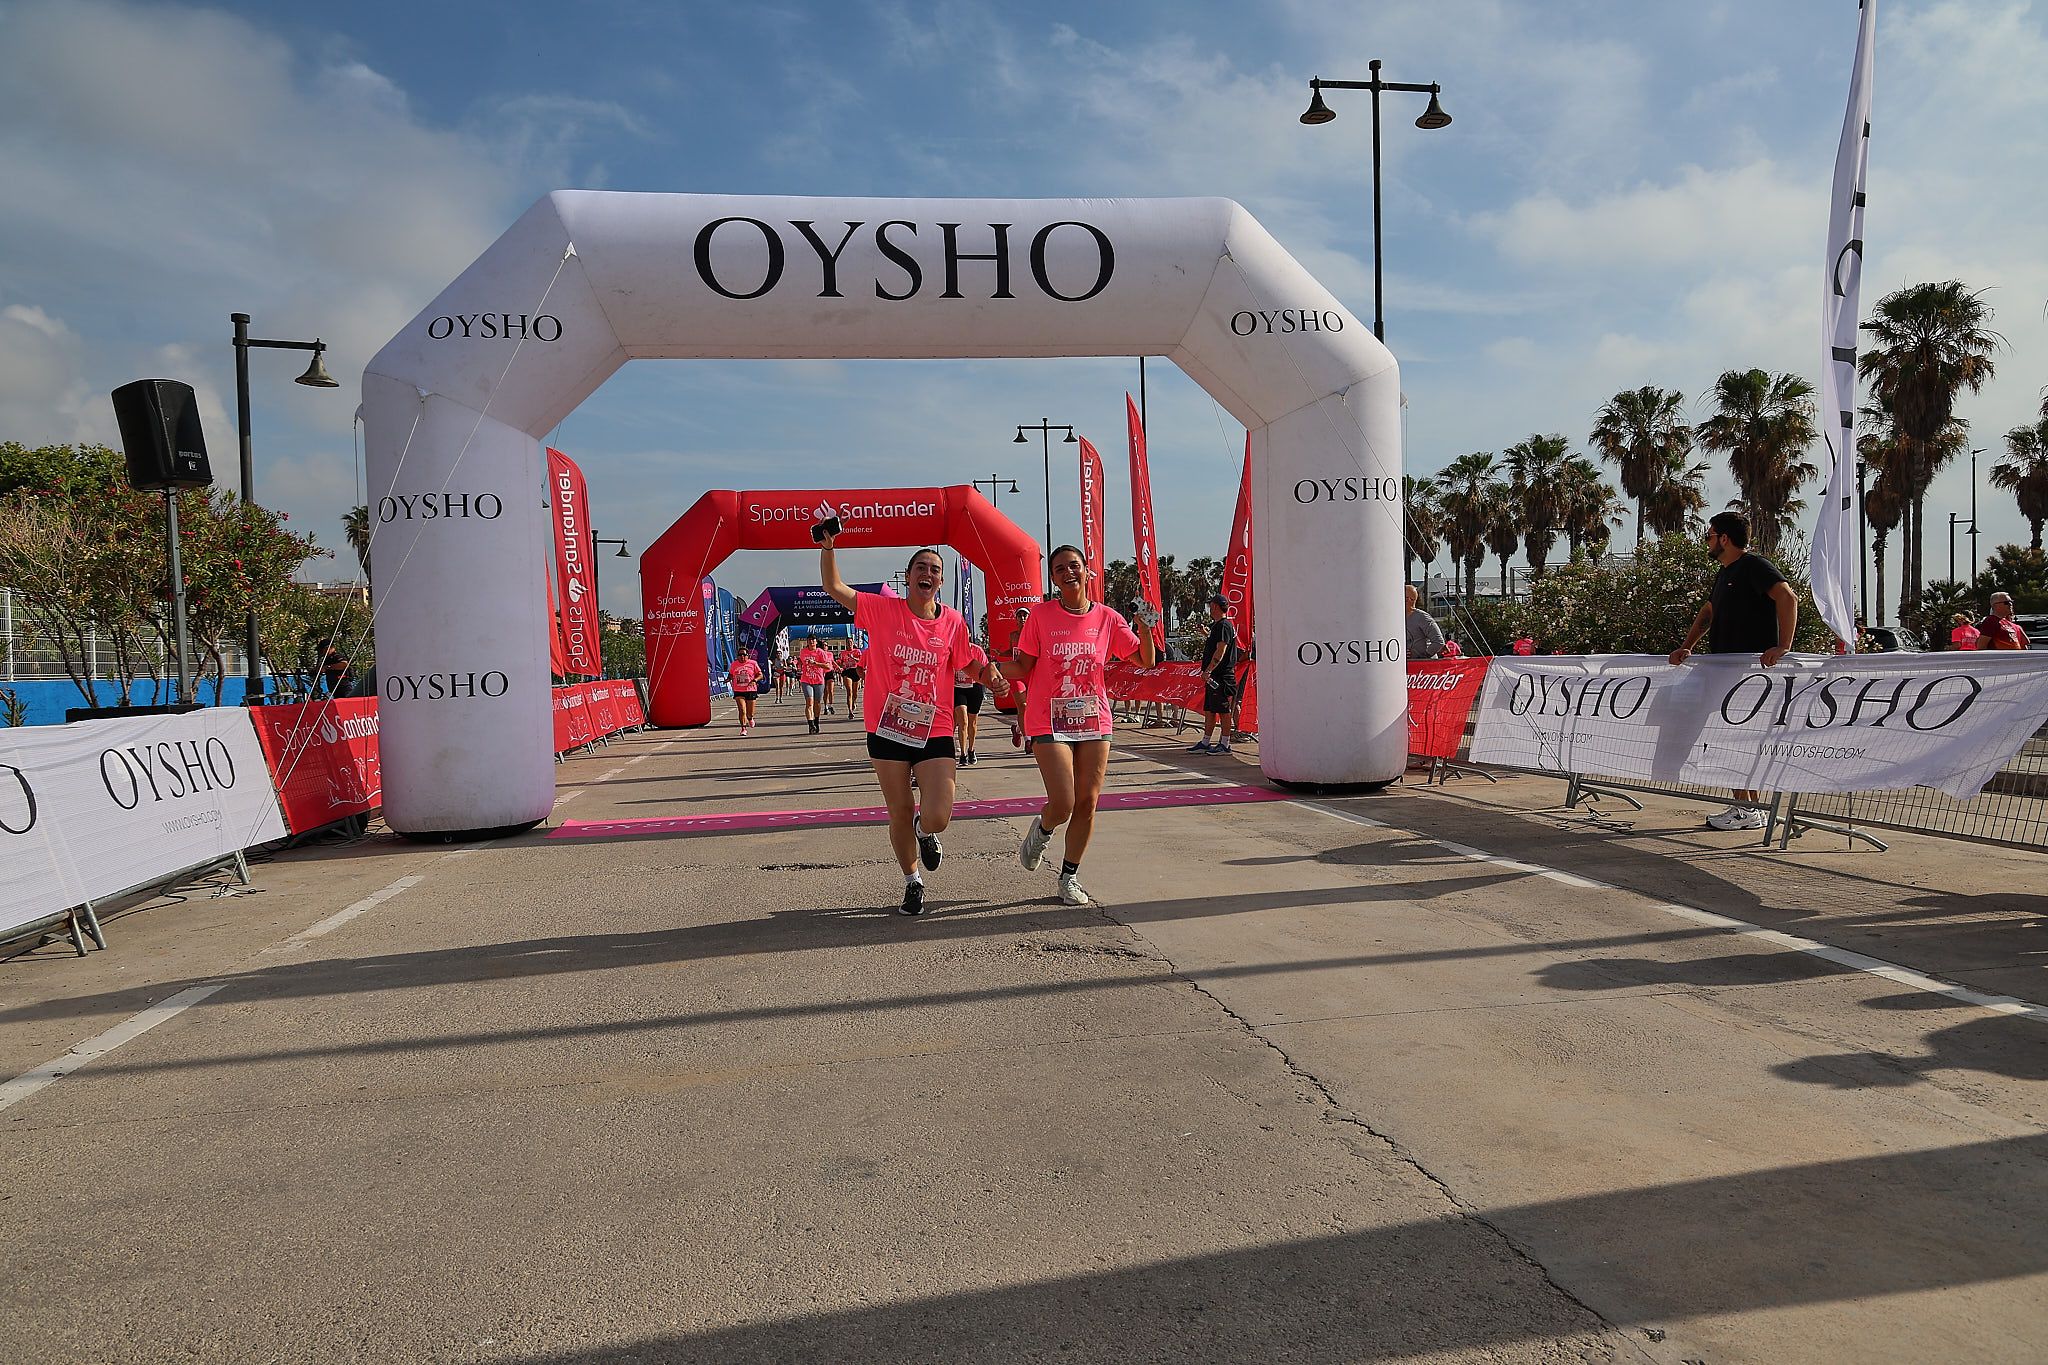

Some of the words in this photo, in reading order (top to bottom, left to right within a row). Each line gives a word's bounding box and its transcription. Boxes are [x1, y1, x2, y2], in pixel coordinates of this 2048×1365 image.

[693, 216, 1115, 301] OYSHO
[427, 313, 563, 342] OYSHO
[1230, 309, 1344, 336] OYSHO
[1293, 477, 1397, 503] OYSHO
[378, 493, 503, 523] OYSHO
[749, 503, 810, 526] Sports
[840, 501, 936, 519] Santander
[1005, 581, 1032, 592] Sports
[656, 595, 686, 606] Sports
[1004, 595, 1041, 604] Santander
[655, 609, 698, 619] Santander
[893, 643, 937, 667] CARRERA
[1052, 642, 1097, 656] CARRERA
[1297, 638, 1400, 666] OYSHO
[386, 670, 509, 702] OYSHO
[1407, 669, 1465, 690] ntander
[1509, 673, 1652, 719] OYSHO
[1720, 673, 1983, 730] OYSHO
[897, 717, 916, 730] 016
[1067, 716, 1086, 726] 016
[274, 720, 322, 759] Sports
[335, 710, 380, 741] Santand
[1758, 743, 1866, 760] WWW.OYSHO.COM
[99, 736, 236, 809] OYSHO
